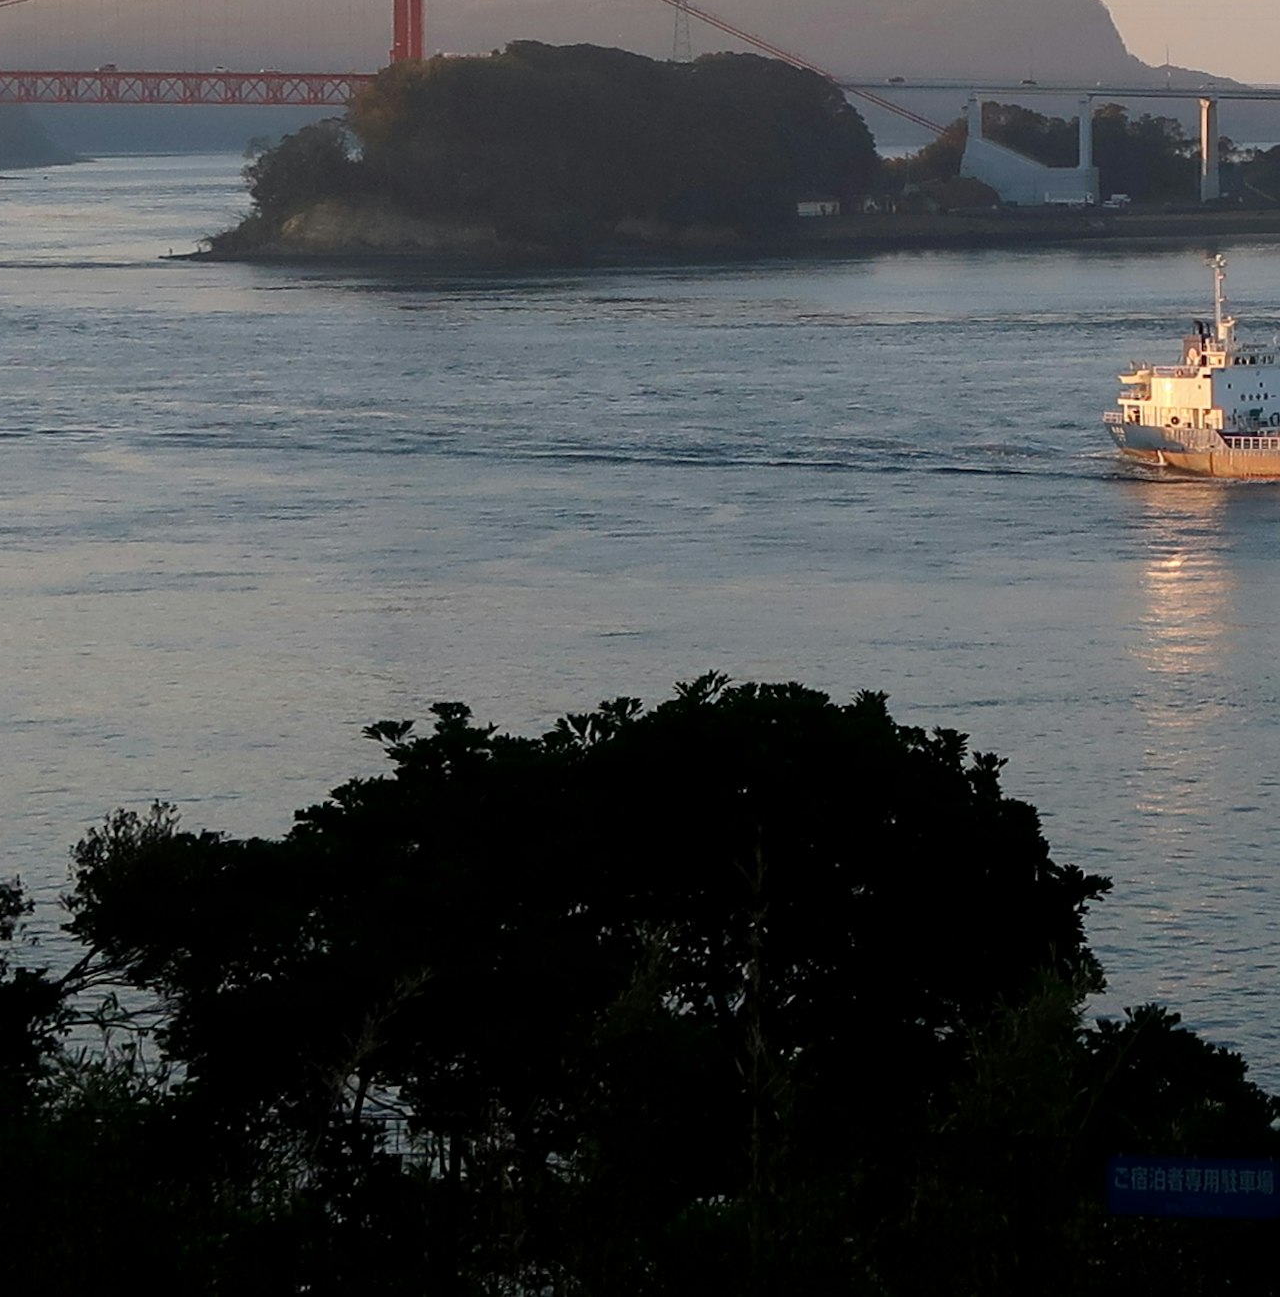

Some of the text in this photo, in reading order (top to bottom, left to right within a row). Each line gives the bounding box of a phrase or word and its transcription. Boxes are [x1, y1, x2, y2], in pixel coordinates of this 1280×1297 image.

[1113, 1166, 1274, 1195] ご宿泊者専用駐車場
